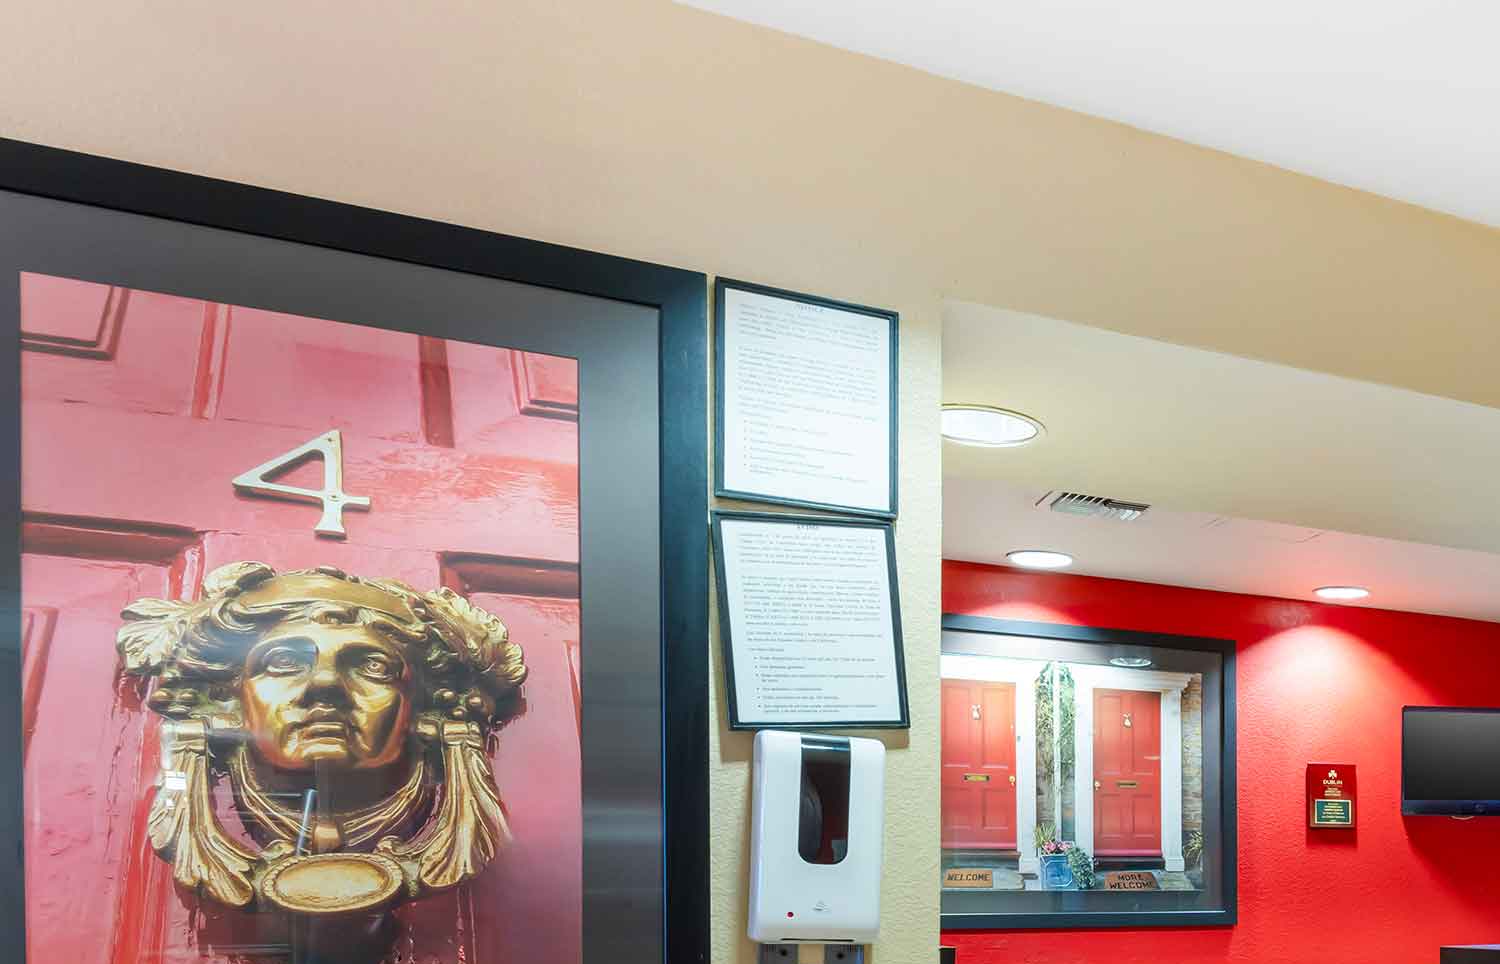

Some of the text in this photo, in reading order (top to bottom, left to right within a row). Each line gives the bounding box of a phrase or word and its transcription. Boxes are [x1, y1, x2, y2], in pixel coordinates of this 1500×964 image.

[232, 429, 371, 540] 4
[947, 873, 991, 881] WELCOME
[1118, 873, 1144, 881] MORE
